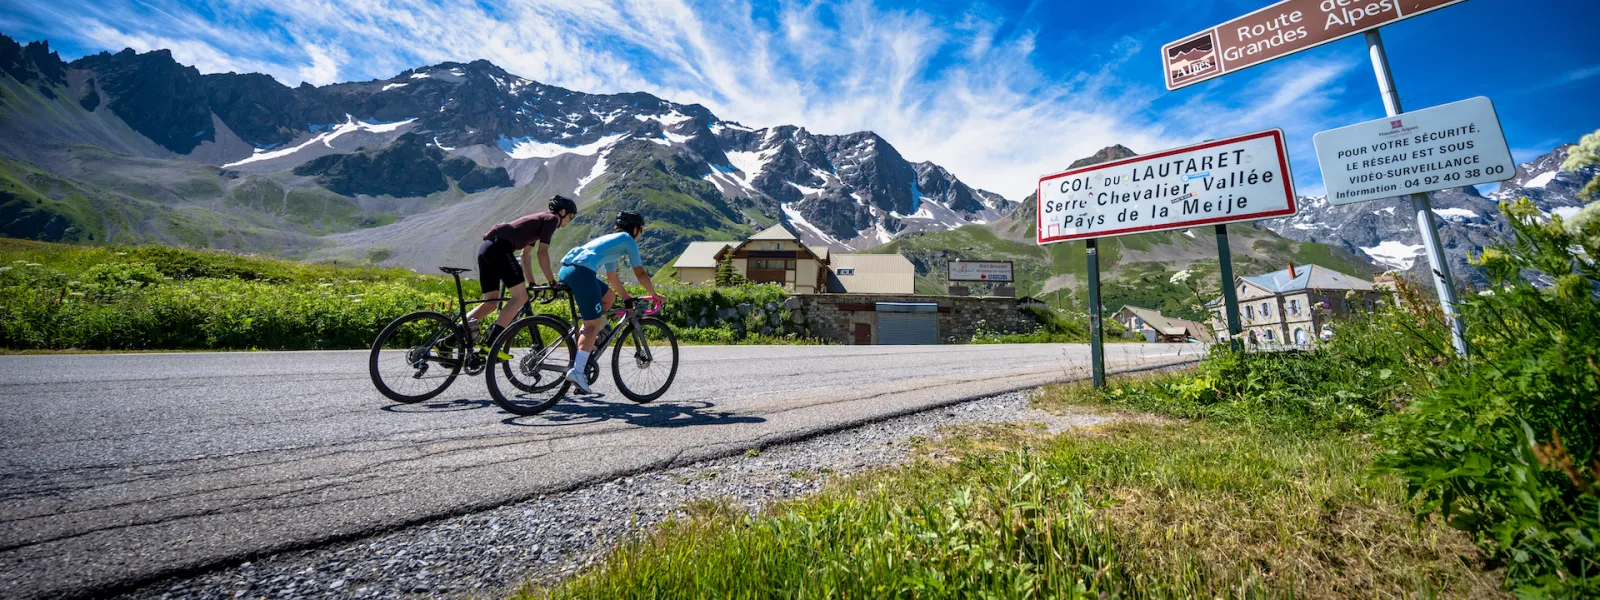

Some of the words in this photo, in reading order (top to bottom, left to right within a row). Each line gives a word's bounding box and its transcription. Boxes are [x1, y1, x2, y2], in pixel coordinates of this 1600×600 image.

[1224, 25, 1308, 62] Grandes
[1324, 0, 1393, 31] Alpes
[1237, 10, 1303, 41] Route
[1319, 0, 1361, 12] de
[1174, 59, 1212, 78] Alpes
[1338, 146, 1367, 159] POUR
[1371, 139, 1409, 152] VOTRE
[1346, 161, 1358, 171] LE
[1362, 154, 1407, 168] RÉSEAU
[1412, 147, 1434, 159] EST
[1439, 140, 1474, 154] SOUS
[1060, 177, 1092, 194] COL
[1104, 175, 1121, 187] DU
[1132, 149, 1245, 182] LAUTARET
[1336, 184, 1397, 199] Information
[1404, 178, 1420, 188] 04
[1424, 175, 1440, 185] 92
[1443, 172, 1460, 181] 40
[1464, 168, 1480, 178] 38
[1485, 164, 1504, 175] 00
[1349, 155, 1480, 184] VIDÉO-SURVEILLANCE
[1045, 199, 1087, 213] Serre
[1097, 183, 1189, 206] Chevalier
[1203, 169, 1273, 191] Vallée
[1063, 213, 1105, 229] Pays
[1117, 207, 1139, 223] de
[1152, 204, 1169, 219] la
[1182, 195, 1248, 215] Meije
